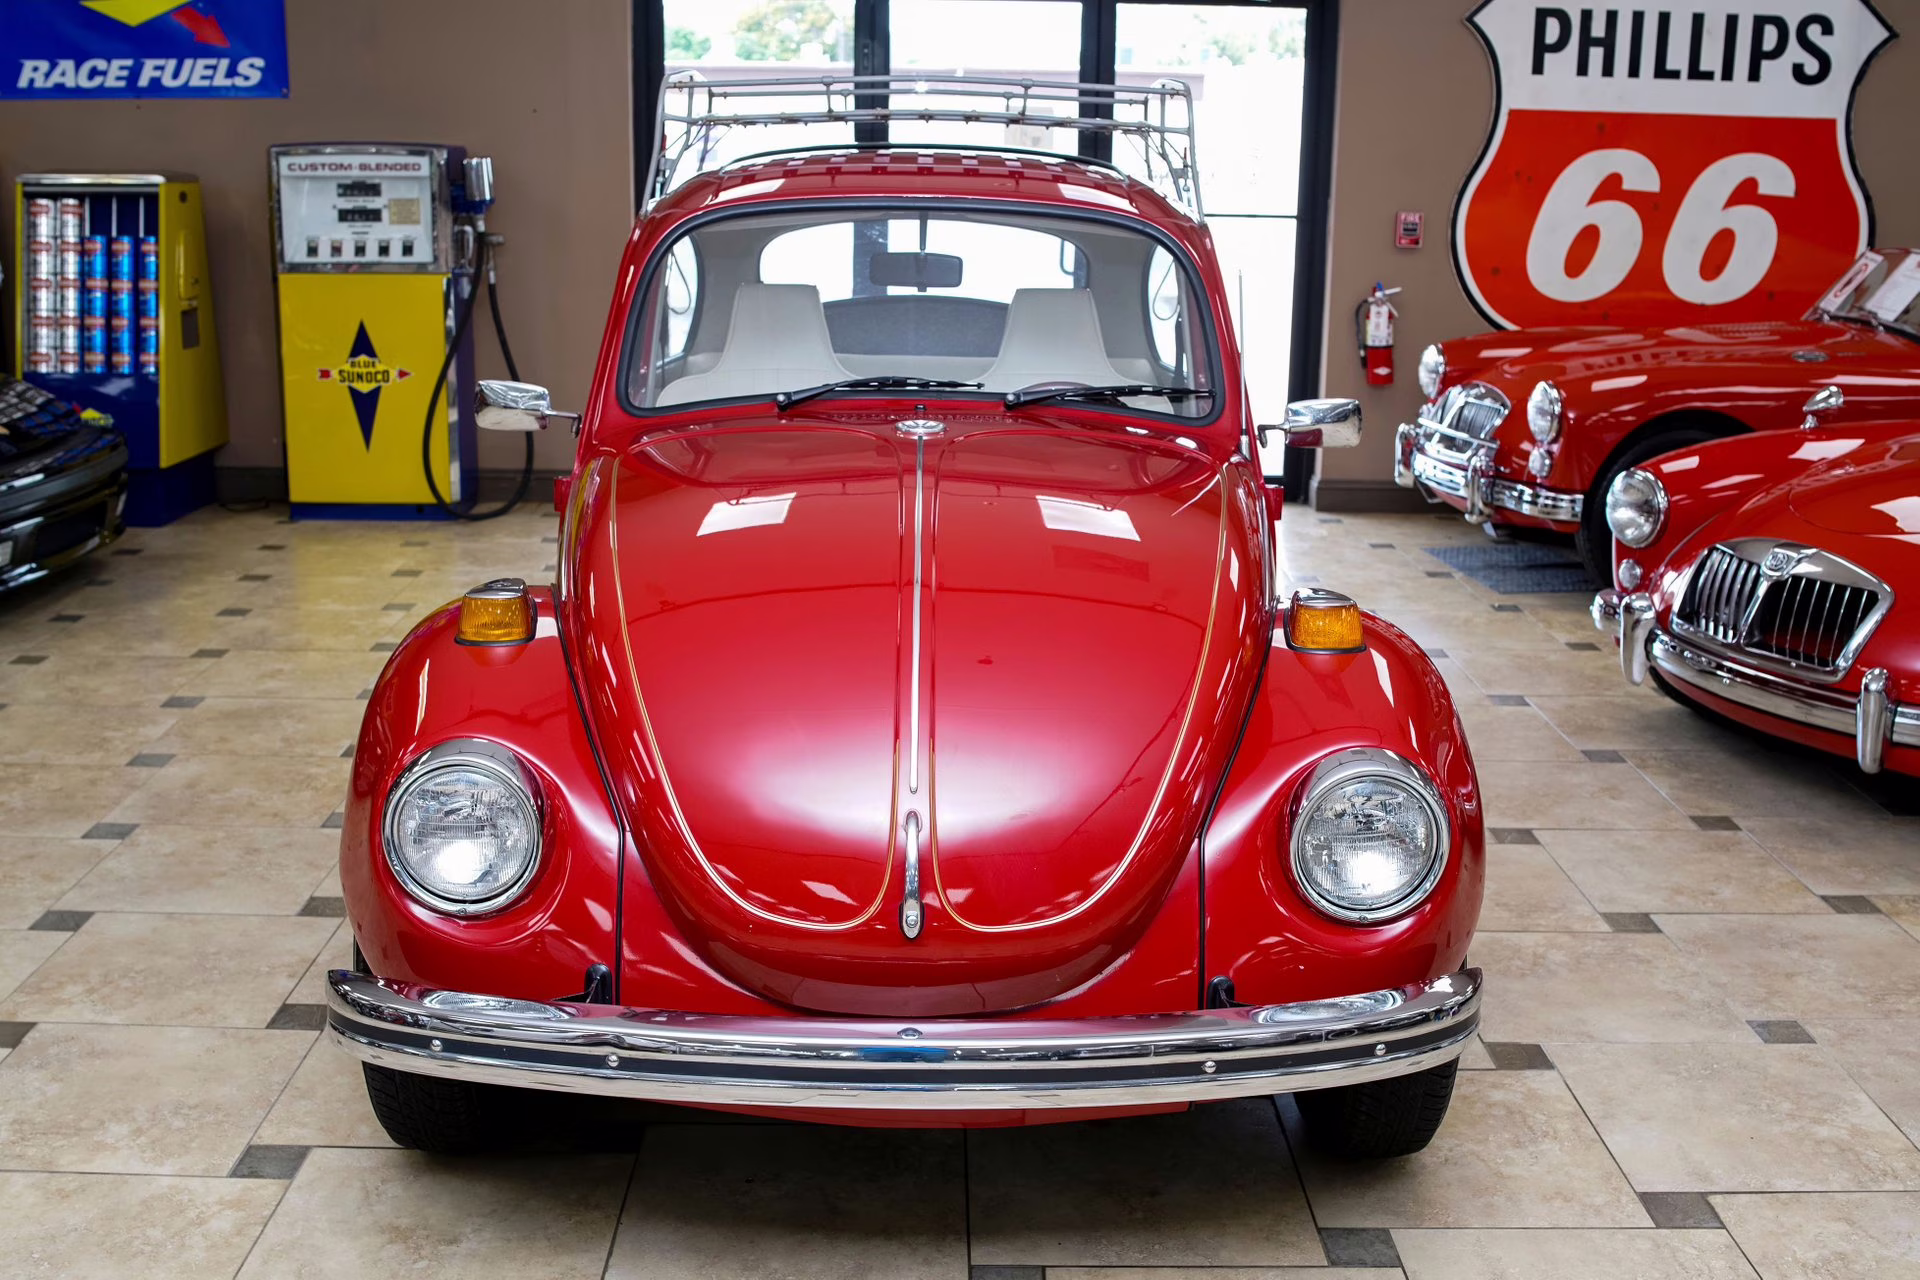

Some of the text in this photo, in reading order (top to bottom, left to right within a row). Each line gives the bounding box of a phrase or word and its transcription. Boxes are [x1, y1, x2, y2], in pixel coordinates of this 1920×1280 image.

[1531, 7, 1835, 86] PHILLIPS
[17, 57, 265, 89] RACE FUELS
[1526, 148, 1796, 306] 66
[338, 369, 391, 384] SUNOCO
[350, 360, 377, 369] BLUE
